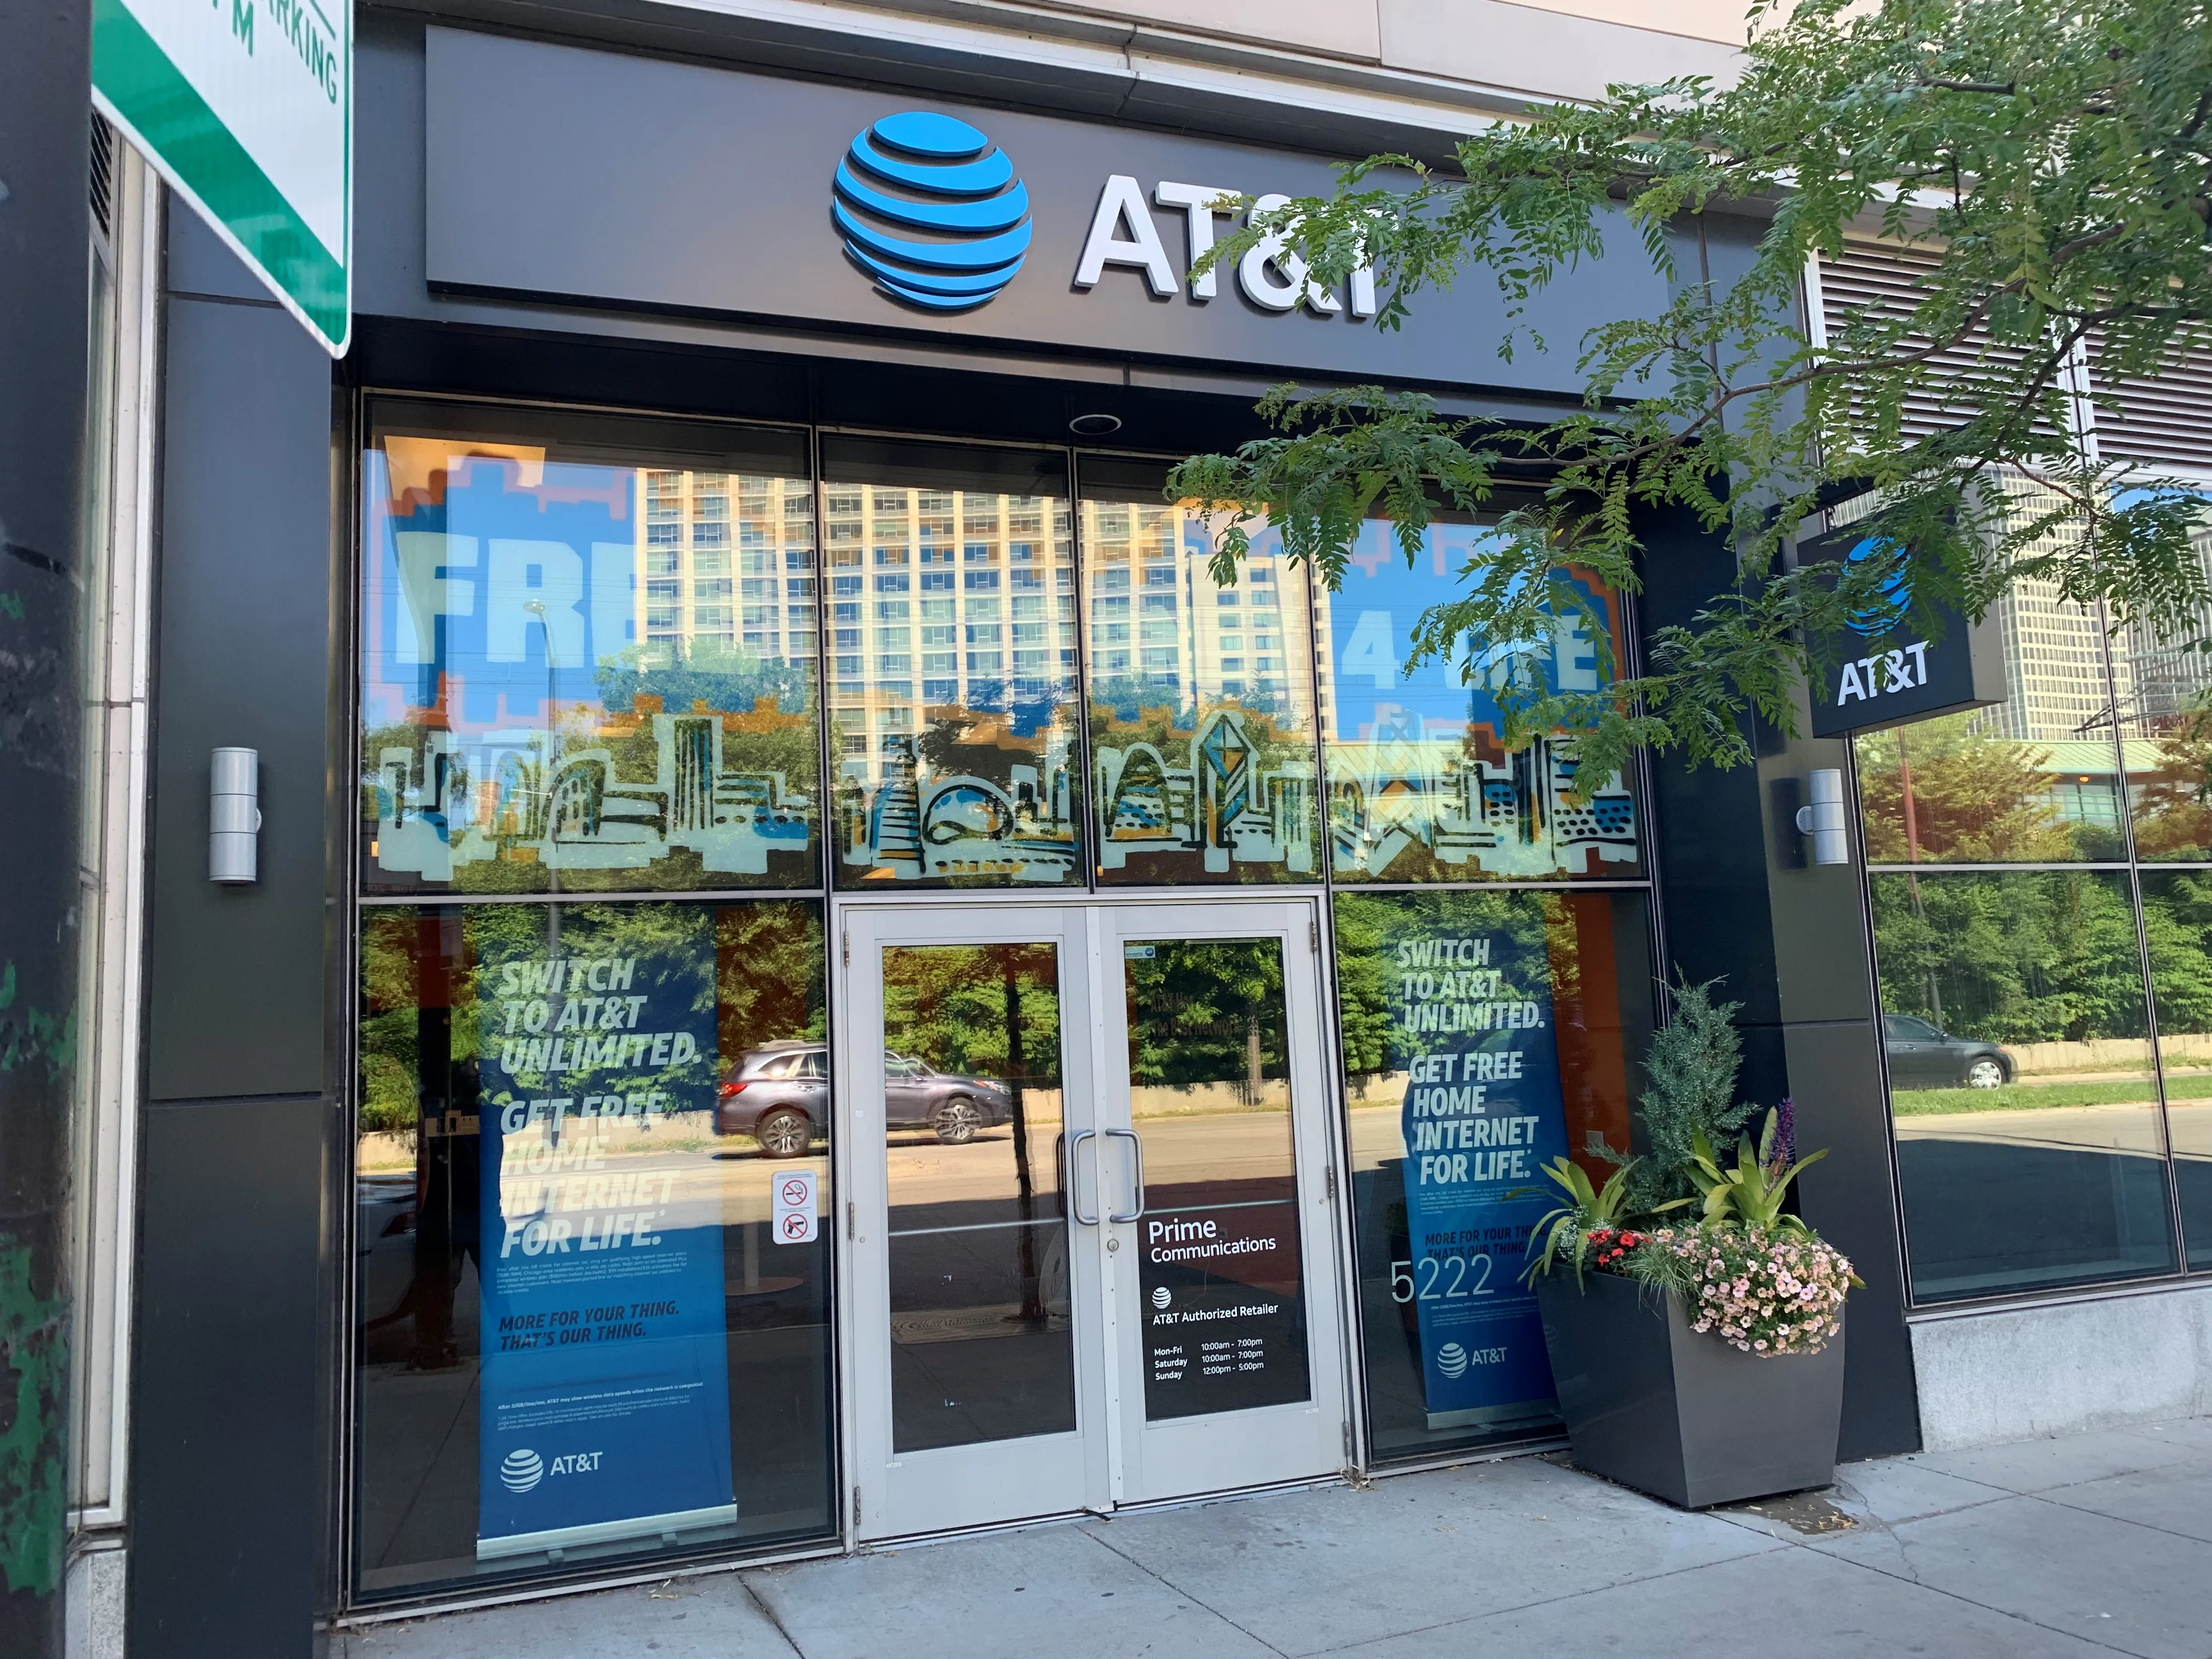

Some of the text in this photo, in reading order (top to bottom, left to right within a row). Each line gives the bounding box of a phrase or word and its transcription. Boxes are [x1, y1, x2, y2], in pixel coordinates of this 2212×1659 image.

[212, 0, 253, 57] M
[269, 0, 337, 104] RKING
[1341, 610, 1401, 690] 4
[1837, 640, 1933, 707] AT&T
[1396, 939, 1491, 968] SWITCH
[498, 958, 636, 995] SWITCH
[1401, 970, 1502, 1000] TO AT&T
[503, 996, 648, 1034] TO AT&T
[1404, 1001, 1545, 1034] UNLIMITED.
[500, 1032, 702, 1074] UNLIMITED.
[1409, 1051, 1523, 1084] GET FREE
[500, 1092, 668, 1135] GET FREE
[1413, 1086, 1486, 1118] HOME
[1417, 1115, 1539, 1152] INTERNET
[501, 1135, 610, 1176] HOME
[1420, 1154, 1468, 1186] FOR
[500, 1170, 680, 1217] INTERNET
[500, 1216, 572, 1259] FOR
[1149, 1217, 1217, 1244] Prime
[1425, 1231, 1457, 1246] MORE
[1459, 1229, 1480, 1243] FOR
[1483, 1227, 1511, 1240] YOUR
[1151, 1236, 1277, 1263] Communications
[1427, 1246, 1465, 1261] THAT'S
[1468, 1244, 1489, 1259] OUR
[1391, 1253, 1494, 1303] 5222
[499, 1300, 680, 1333] MORE FOR YOUR THING.
[1153, 1304, 1278, 1325] AT&T Authorized Retailer
[500, 1322, 646, 1351] THAT'S OUR THING.
[1154, 1345, 1182, 1357] Mon-Fri
[1201, 1341, 1229, 1351] 10:00am
[1237, 1338, 1262, 1348] 7:00pm
[1155, 1358, 1188, 1369] Saturday
[1201, 1353, 1231, 1363] 10:00am
[1238, 1350, 1263, 1360] 7:00pm
[1155, 1370, 1183, 1381] Sunday
[1203, 1365, 1231, 1375] 12:00pm
[1238, 1361, 1264, 1372] 5:00pm
[1472, 1347, 1507, 1366] AT&T
[550, 1451, 603, 1476] AT&T
